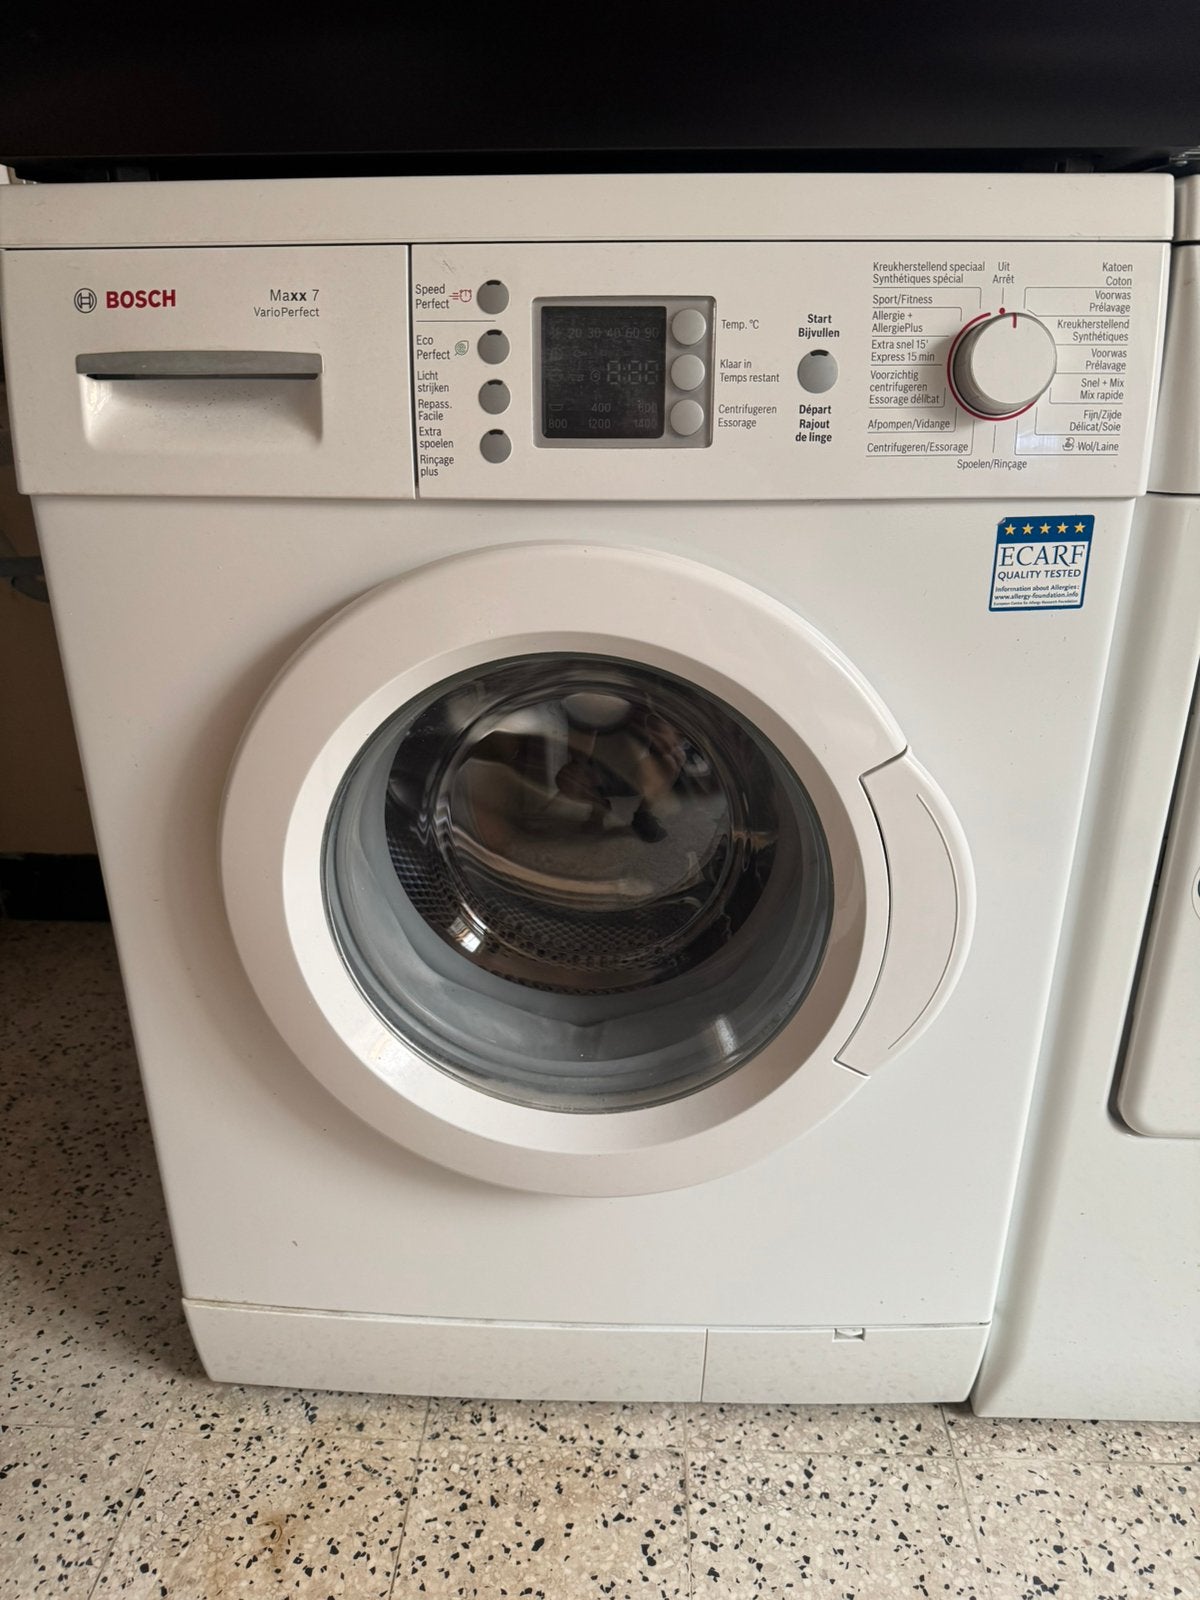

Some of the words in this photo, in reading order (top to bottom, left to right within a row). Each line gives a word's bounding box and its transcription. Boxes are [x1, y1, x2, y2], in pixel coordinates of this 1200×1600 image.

[873, 262, 947, 272] Kreukherstellend
[949, 262, 985, 272] speciaal
[998, 262, 1010, 271] Uit
[1102, 262, 1133, 272] Katoen
[873, 274, 931, 285] Synthétiques
[933, 274, 963, 285] spécial
[992, 274, 1014, 284] Arrêt
[1106, 276, 1132, 286] Coton
[416, 284, 445, 295] Speed
[1095, 290, 1131, 300] Voorwas
[106, 290, 176, 308] BOSCH
[270, 289, 307, 302] Maxx
[312, 289, 319, 301] 7
[873, 294, 932, 305] Sport/Fitness
[416, 298, 450, 309] Perfect
[1089, 302, 1130, 314] Prélavage
[253, 307, 319, 317] VarioPerfect
[872, 311, 905, 321] Allergie
[808, 314, 832, 323] Start
[721, 320, 747, 330] Temp.
[872, 323, 923, 334] AllergiePlus
[1057, 320, 1129, 329] Kreukherstellend
[798, 328, 840, 339] Bijvullen
[1073, 332, 1128, 343] Synthétiques
[417, 335, 433, 345] Eco
[872, 340, 895, 349] Extra
[896, 340, 914, 349] snel
[417, 350, 450, 360] Perfect
[871, 353, 905, 363] Express
[908, 353, 917, 361] 15
[919, 353, 934, 361] min
[1091, 349, 1127, 358] Voorwas
[720, 360, 741, 368] Klaar
[744, 360, 752, 368] in
[1086, 360, 1126, 372] Prélavage
[417, 371, 438, 380] Licht
[720, 373, 747, 384] Temps
[749, 373, 779, 382] restant
[870, 370, 918, 380] Voorzichtig
[1081, 378, 1099, 387] Snel
[1110, 378, 1124, 387] Mix
[418, 383, 449, 394] strijken
[870, 384, 928, 393] centrifugeren
[870, 395, 908, 405] Essorage
[1080, 390, 1094, 399] Mix
[1097, 390, 1123, 401] rapide
[418, 399, 452, 410] Repass.
[719, 404, 776, 415] Centrifugeren
[419, 411, 443, 421] Facile
[799, 405, 831, 416] Départ
[1084, 410, 1122, 421] Fijn/Zijde
[718, 418, 756, 429] Essorage
[800, 419, 830, 430] Rajout
[868, 419, 950, 430] Afpompen/Vidange
[1070, 422, 1120, 432] Délicat/Soie
[419, 427, 441, 436] Extra
[796, 433, 807, 442] de
[809, 432, 832, 444] linge
[420, 439, 454, 449] spoelen
[867, 442, 968, 453] Centrifugeren/Essorage
[1078, 442, 1119, 452] Wol/Laine
[420, 455, 454, 466] Rinçage
[957, 459, 1027, 470] Spoelen/Rinçage
[421, 466, 438, 477] plus
[999, 544, 1085, 566] ECARF
[998, 571, 1041, 581] QUALITY
[1044, 569, 1081, 578] TESTED
